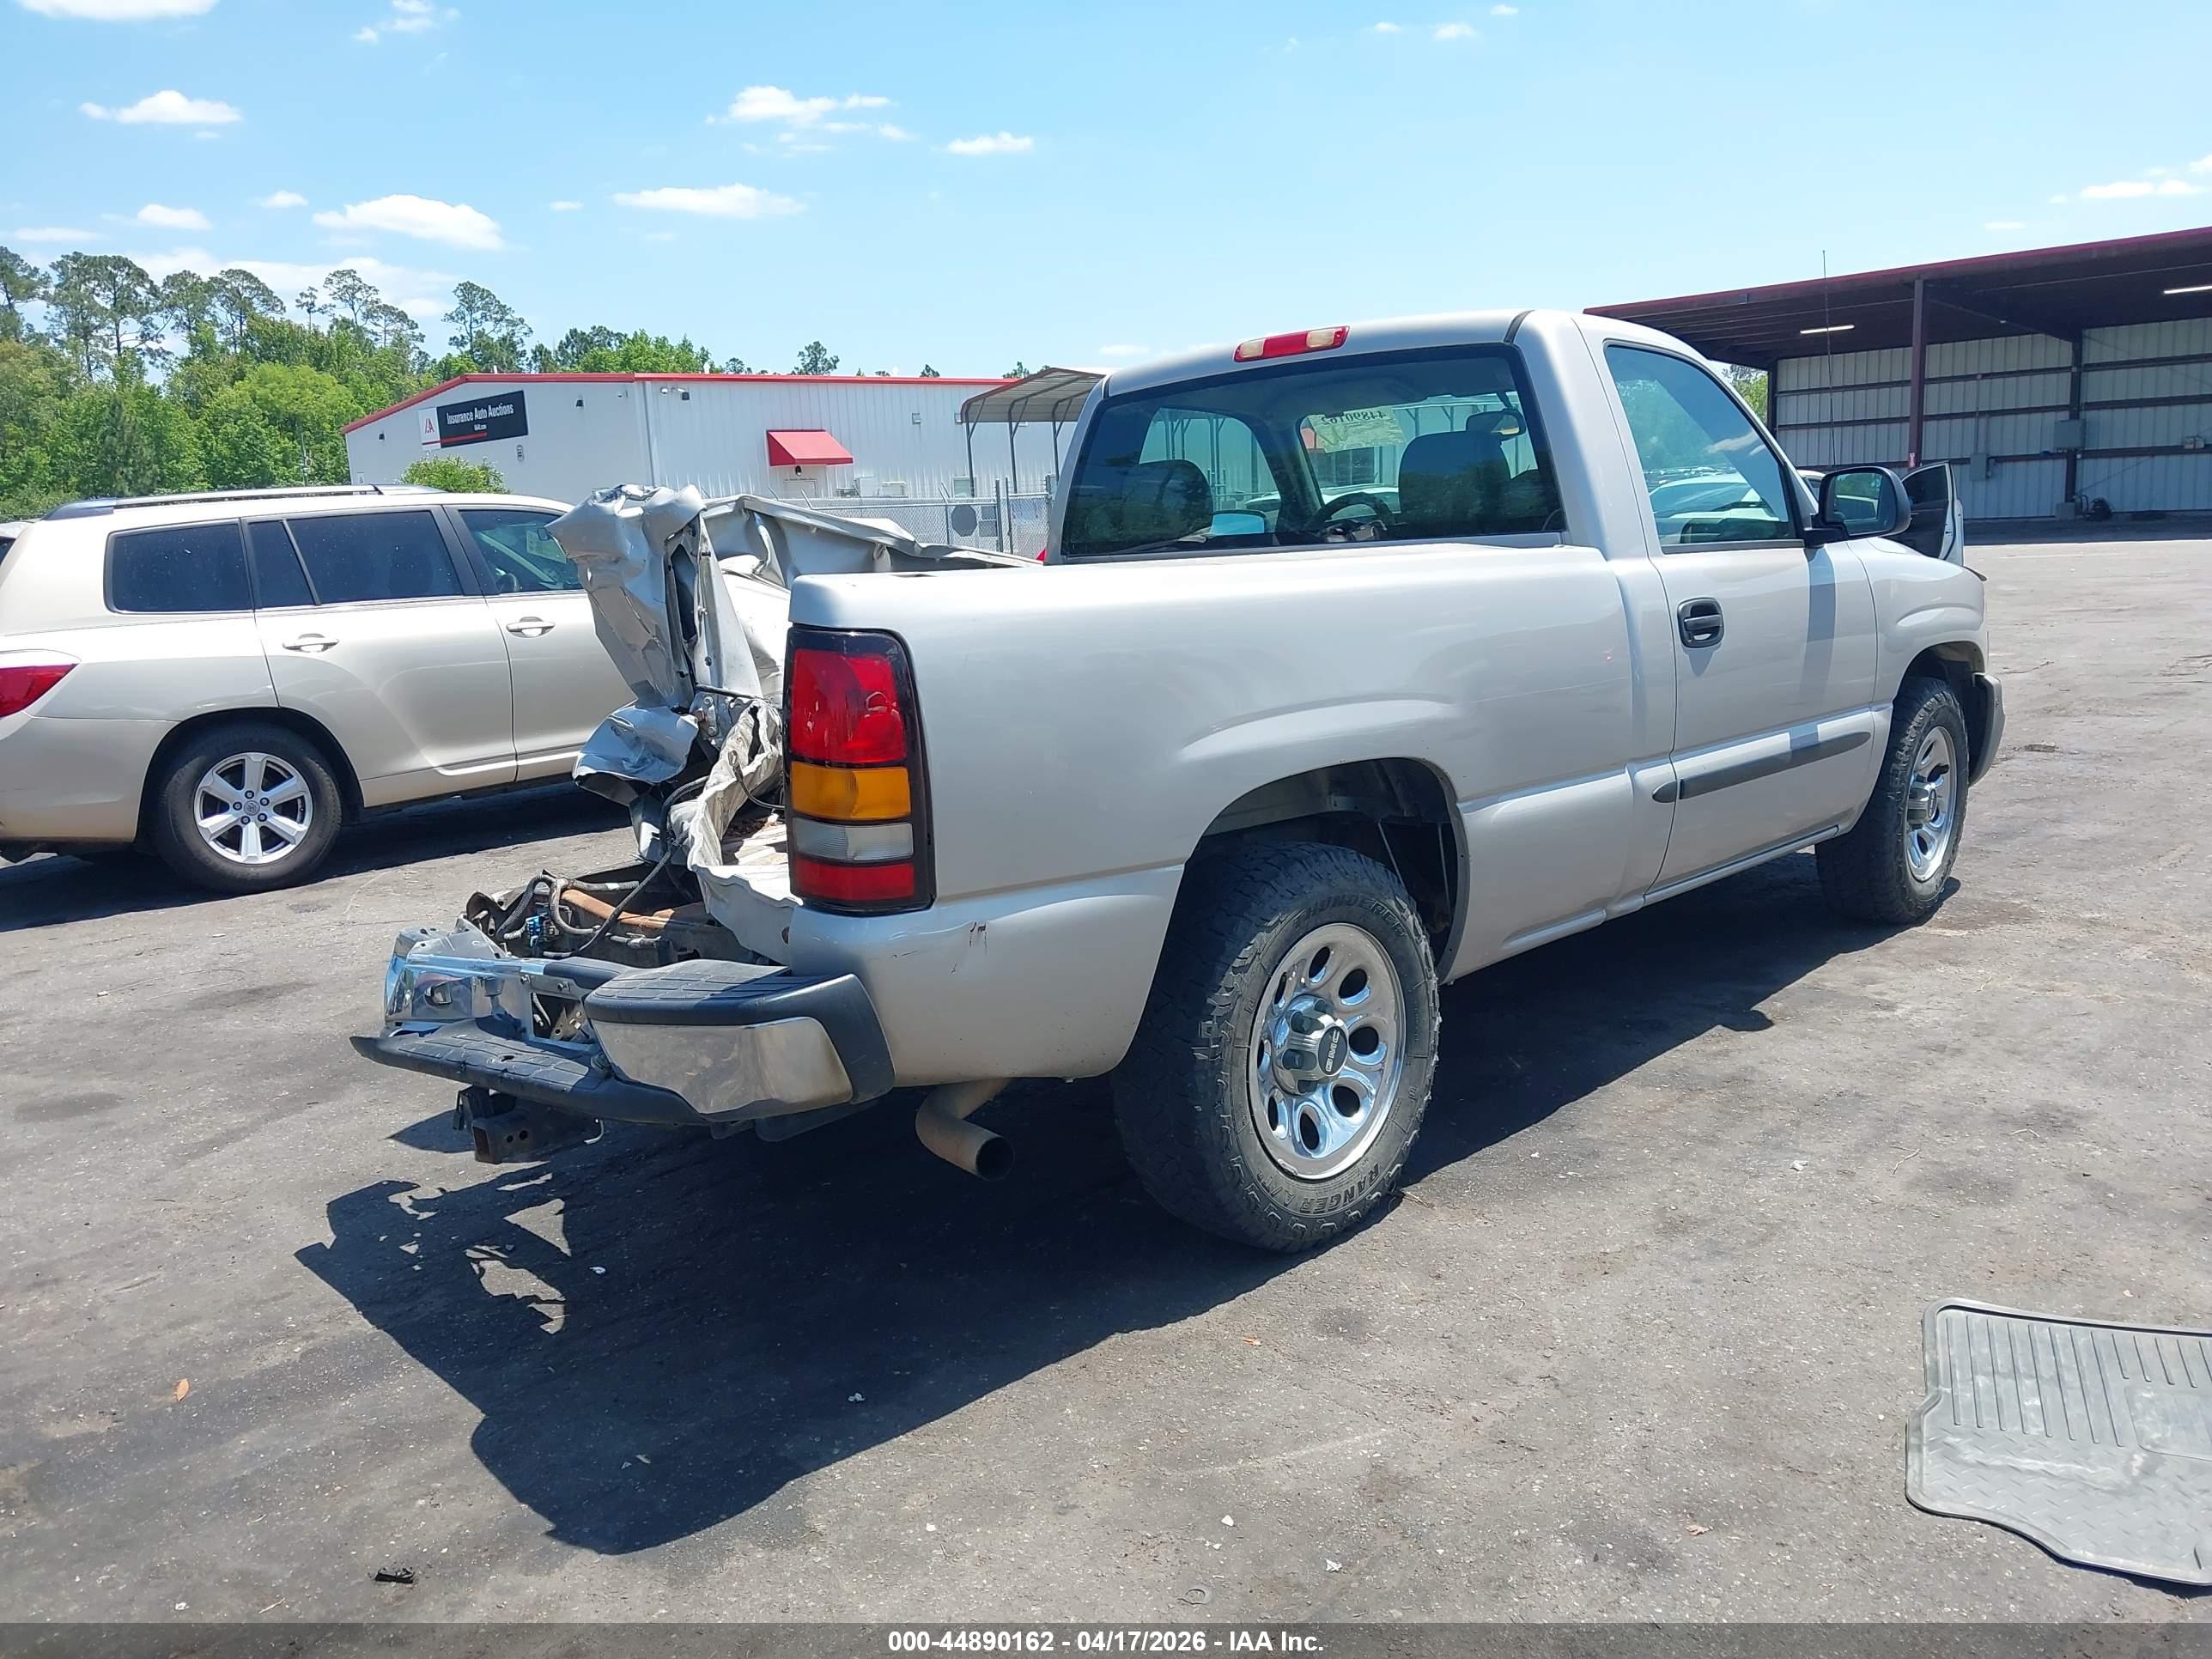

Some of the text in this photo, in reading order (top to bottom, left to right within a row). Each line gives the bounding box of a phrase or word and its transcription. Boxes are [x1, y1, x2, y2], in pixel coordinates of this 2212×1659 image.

[447, 402, 514, 425] Insurance Auto Auctions
[1325, 1029, 1340, 1073] GMC
[1299, 1162, 1381, 1214] RANGER
